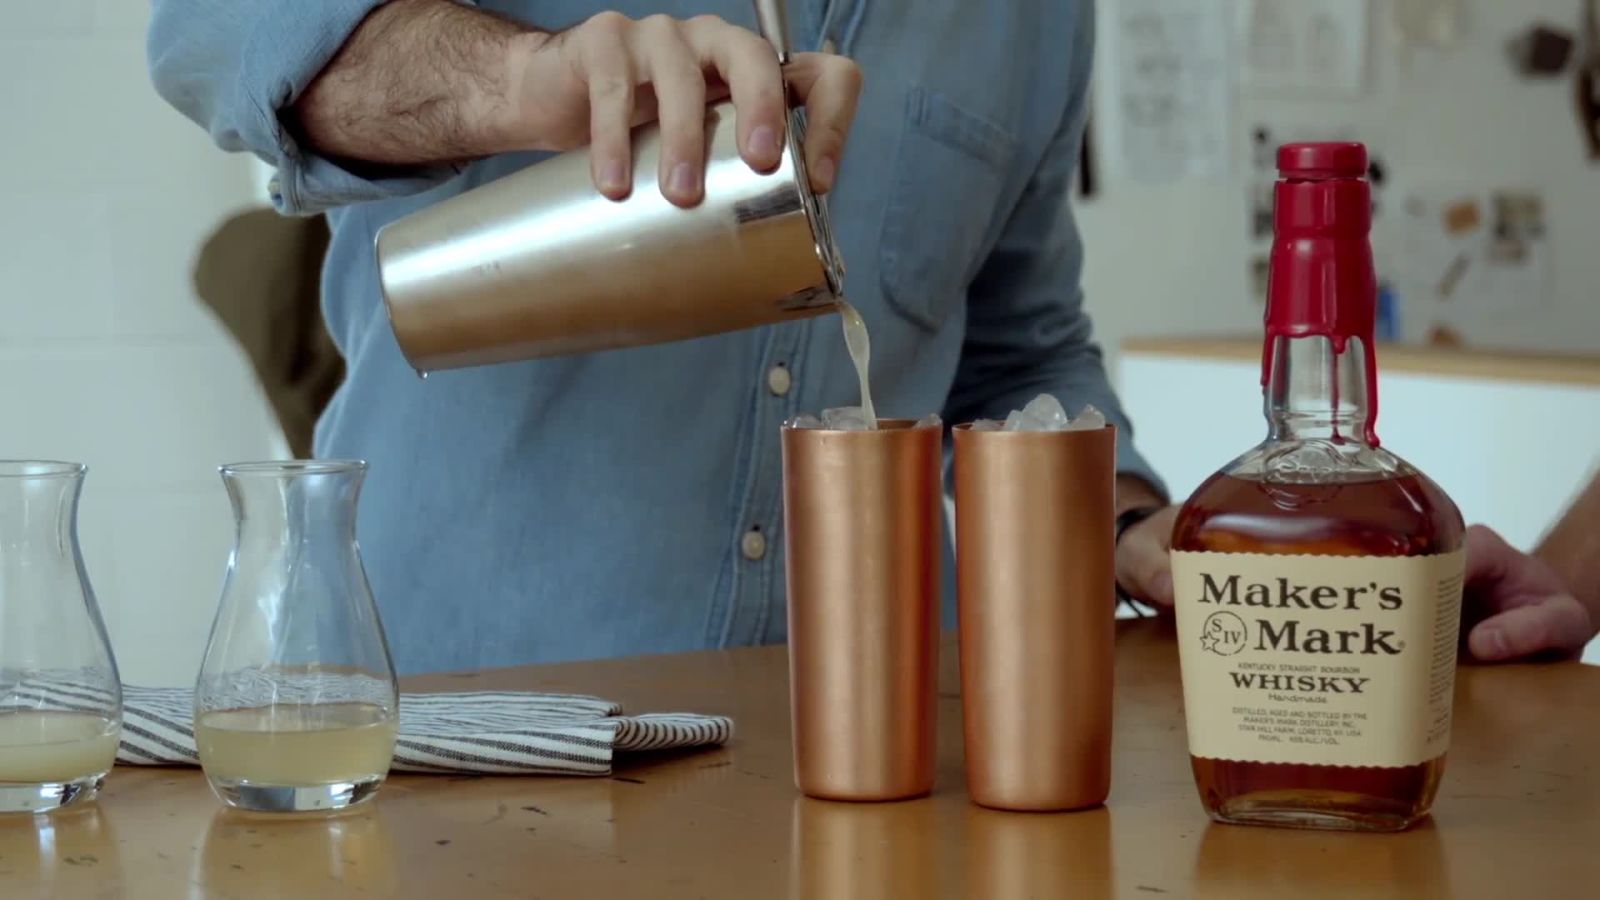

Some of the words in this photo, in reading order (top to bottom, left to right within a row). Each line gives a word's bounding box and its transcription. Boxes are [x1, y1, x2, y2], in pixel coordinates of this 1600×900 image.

[1197, 573, 1403, 611] Maker's
[1253, 619, 1401, 655] Mark
[1238, 662, 1276, 671] KENTUCKY
[1279, 664, 1317, 673] STRAIGHT
[1320, 665, 1360, 674] BOURBON
[1229, 671, 1371, 694] WHISKY
[1268, 693, 1327, 704] Handmade
